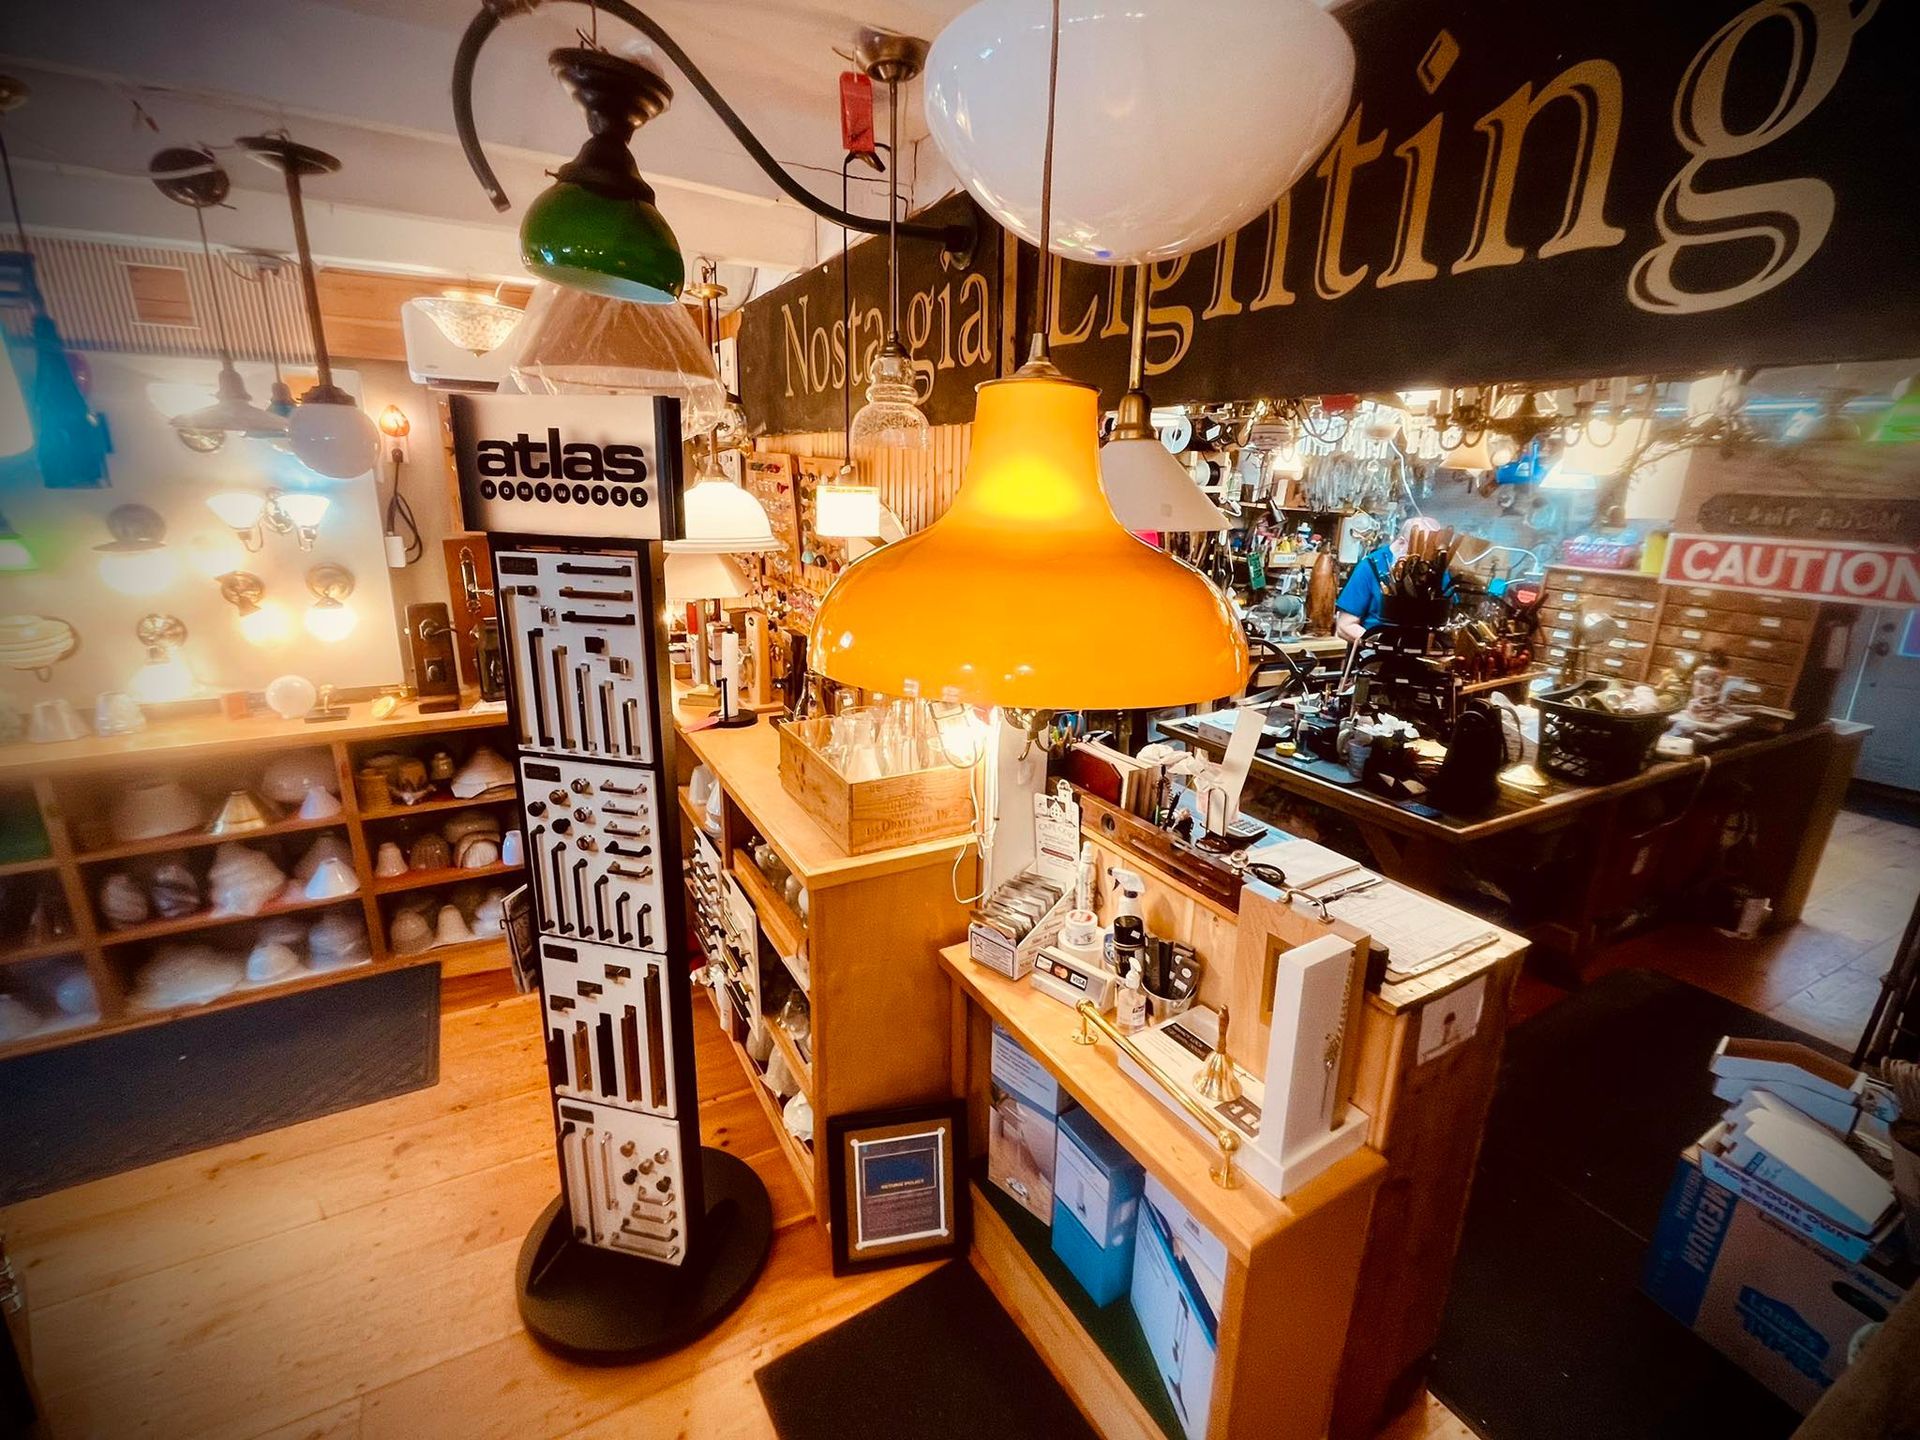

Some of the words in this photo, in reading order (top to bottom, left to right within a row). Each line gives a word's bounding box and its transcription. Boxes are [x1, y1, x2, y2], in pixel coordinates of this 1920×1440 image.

[781, 249, 992, 406] Nostagia
[477, 428, 647, 483] atlas
[482, 482, 646, 506] HOMEWARES
[1682, 541, 1920, 602] CAUTION
[1681, 1182, 1734, 1273] MEDIUM
[1807, 1214, 1851, 1242] OWN
